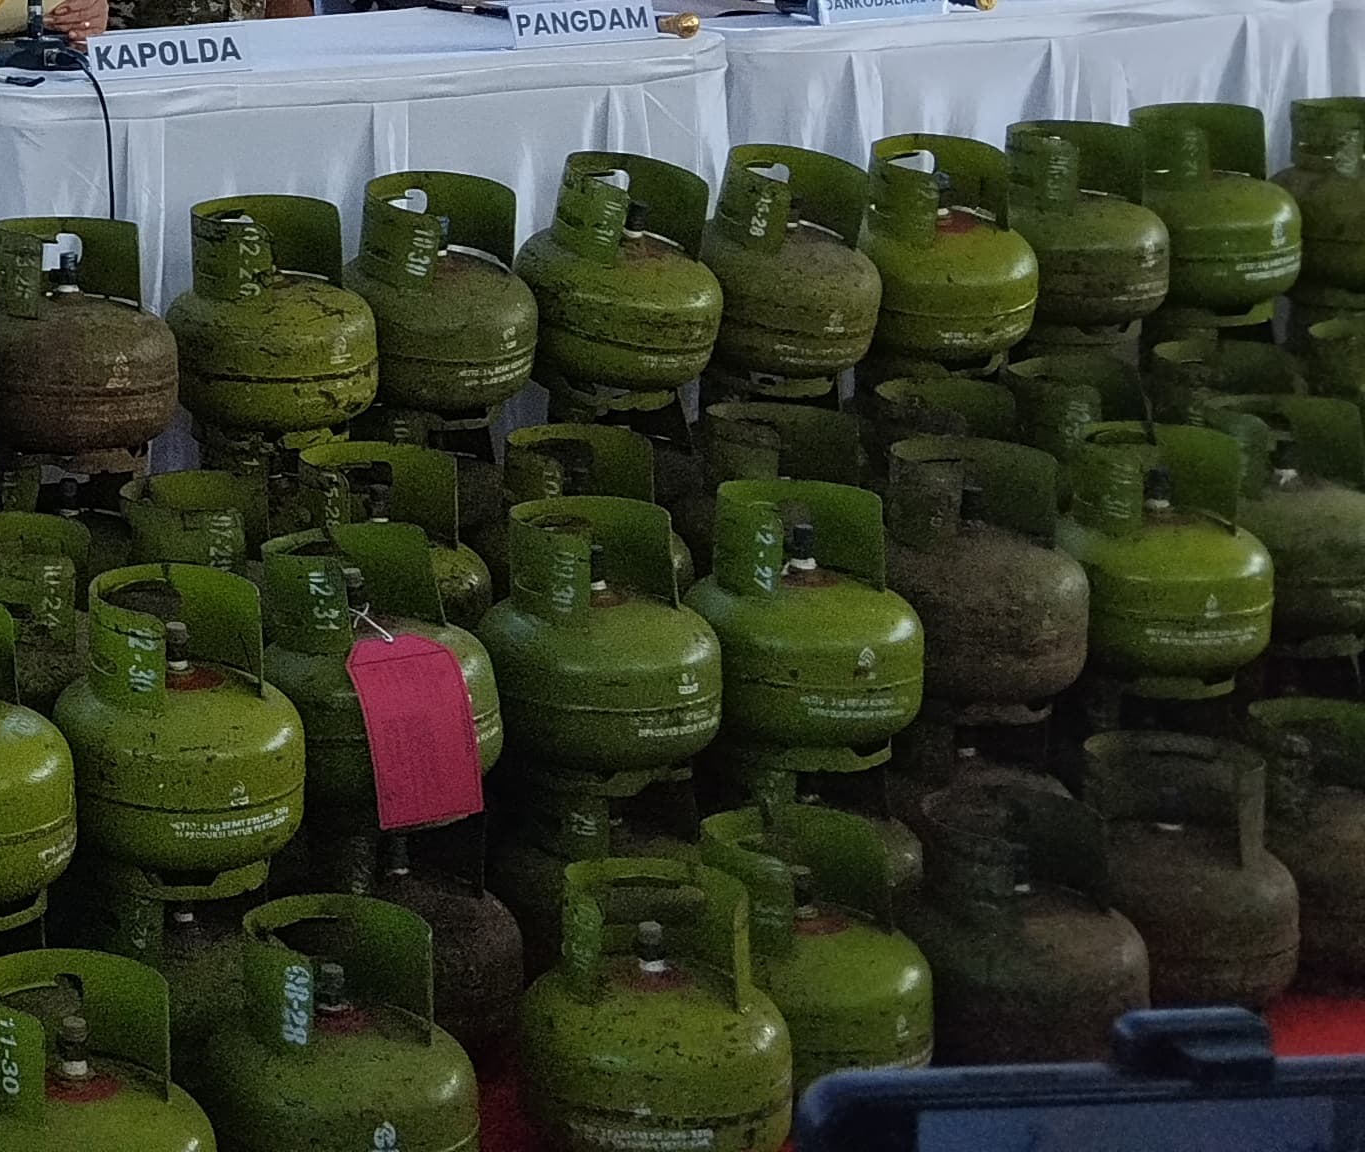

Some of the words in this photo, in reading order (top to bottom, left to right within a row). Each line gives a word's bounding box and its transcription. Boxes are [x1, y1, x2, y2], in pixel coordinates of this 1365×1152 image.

[516, 7, 649, 37] PANGDAM
[95, 37, 242, 71] KAPOLDA
[0, 1017, 20, 1095] 11-30
